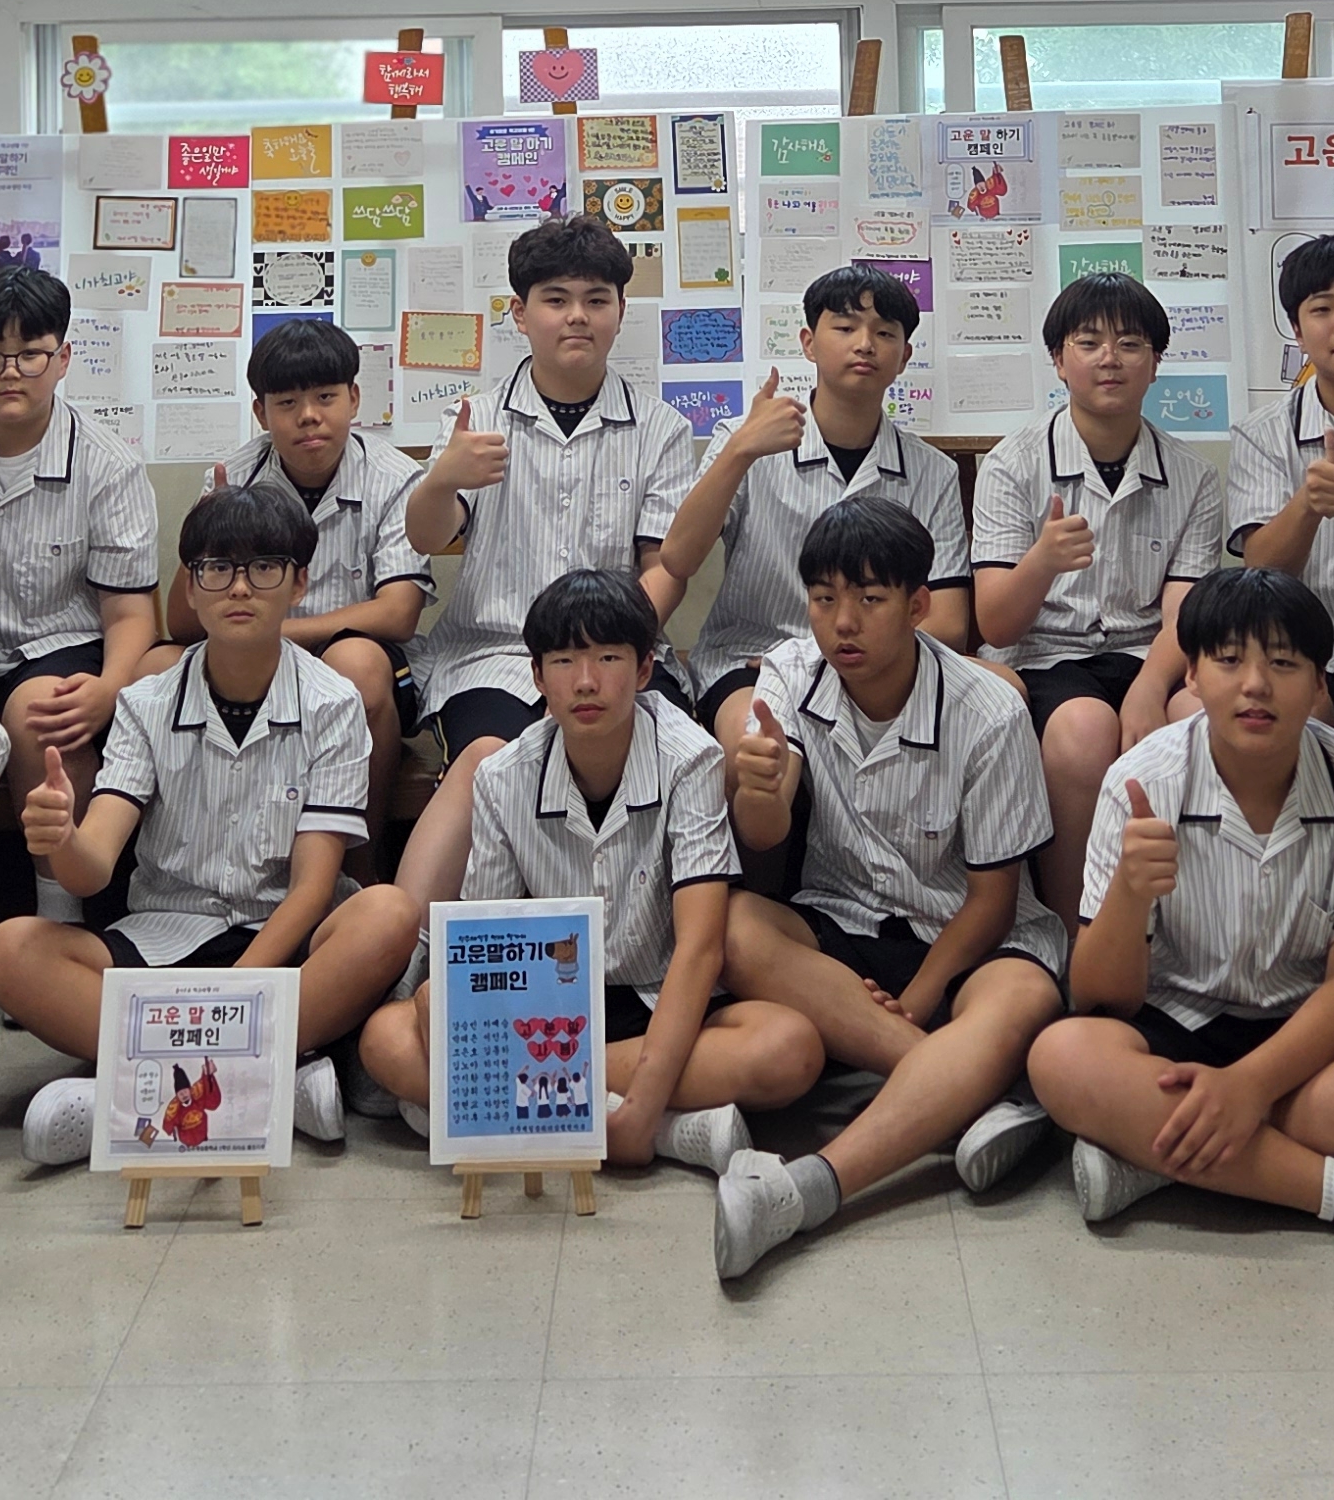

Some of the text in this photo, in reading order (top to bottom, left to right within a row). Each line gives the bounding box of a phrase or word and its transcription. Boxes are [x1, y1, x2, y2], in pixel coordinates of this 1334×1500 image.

[379, 64, 430, 82] 함께라서
[388, 82, 424, 100] 행복해
[950, 128, 1020, 142] 고운 말 하기
[496, 151, 539, 167] 캠페인
[771, 136, 829, 165] 감사해요
[966, 143, 1004, 156] 캠페인
[352, 202, 412, 229] 쓰담쓰담
[614, 213, 635, 222] HAPPY
[1158, 387, 1211, 422] 웃어요
[448, 941, 544, 965] 고운말하기
[470, 970, 528, 993] 캠페인
[146, 1004, 245, 1025] 고운 말 하기
[169, 1027, 221, 1047] 캠페인
